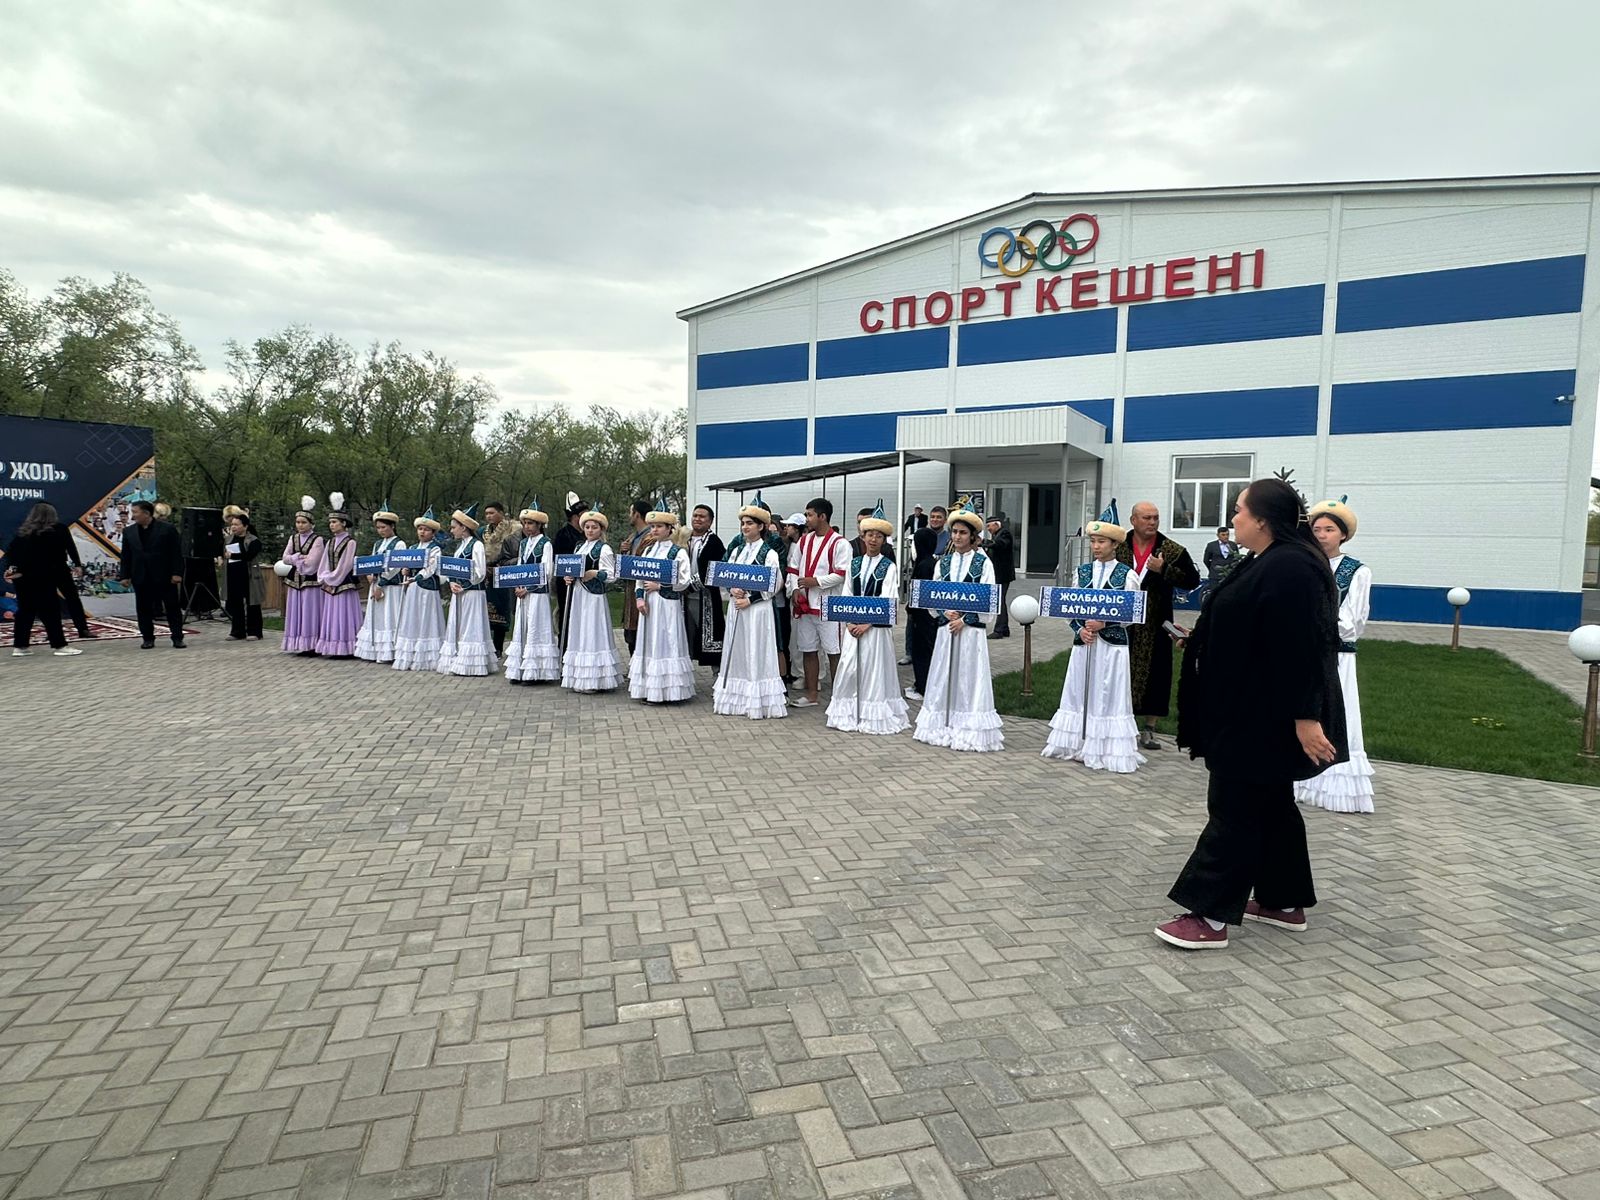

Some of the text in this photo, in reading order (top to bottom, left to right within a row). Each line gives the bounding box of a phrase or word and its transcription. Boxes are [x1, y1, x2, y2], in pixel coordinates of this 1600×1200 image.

[860, 249, 1265, 333] СПОРТ КЕШЕНІ
[718, 569, 765, 583] АЙТУ БИ А.О.
[930, 590, 979, 602] ЕЛТАЙ А.О.
[1059, 592, 1125, 604] ЖОЛБАРЫС
[833, 604, 885, 616] ЕСКЕЛДІ А.О.
[1061, 604, 1121, 617] БАТЫР А.О.
